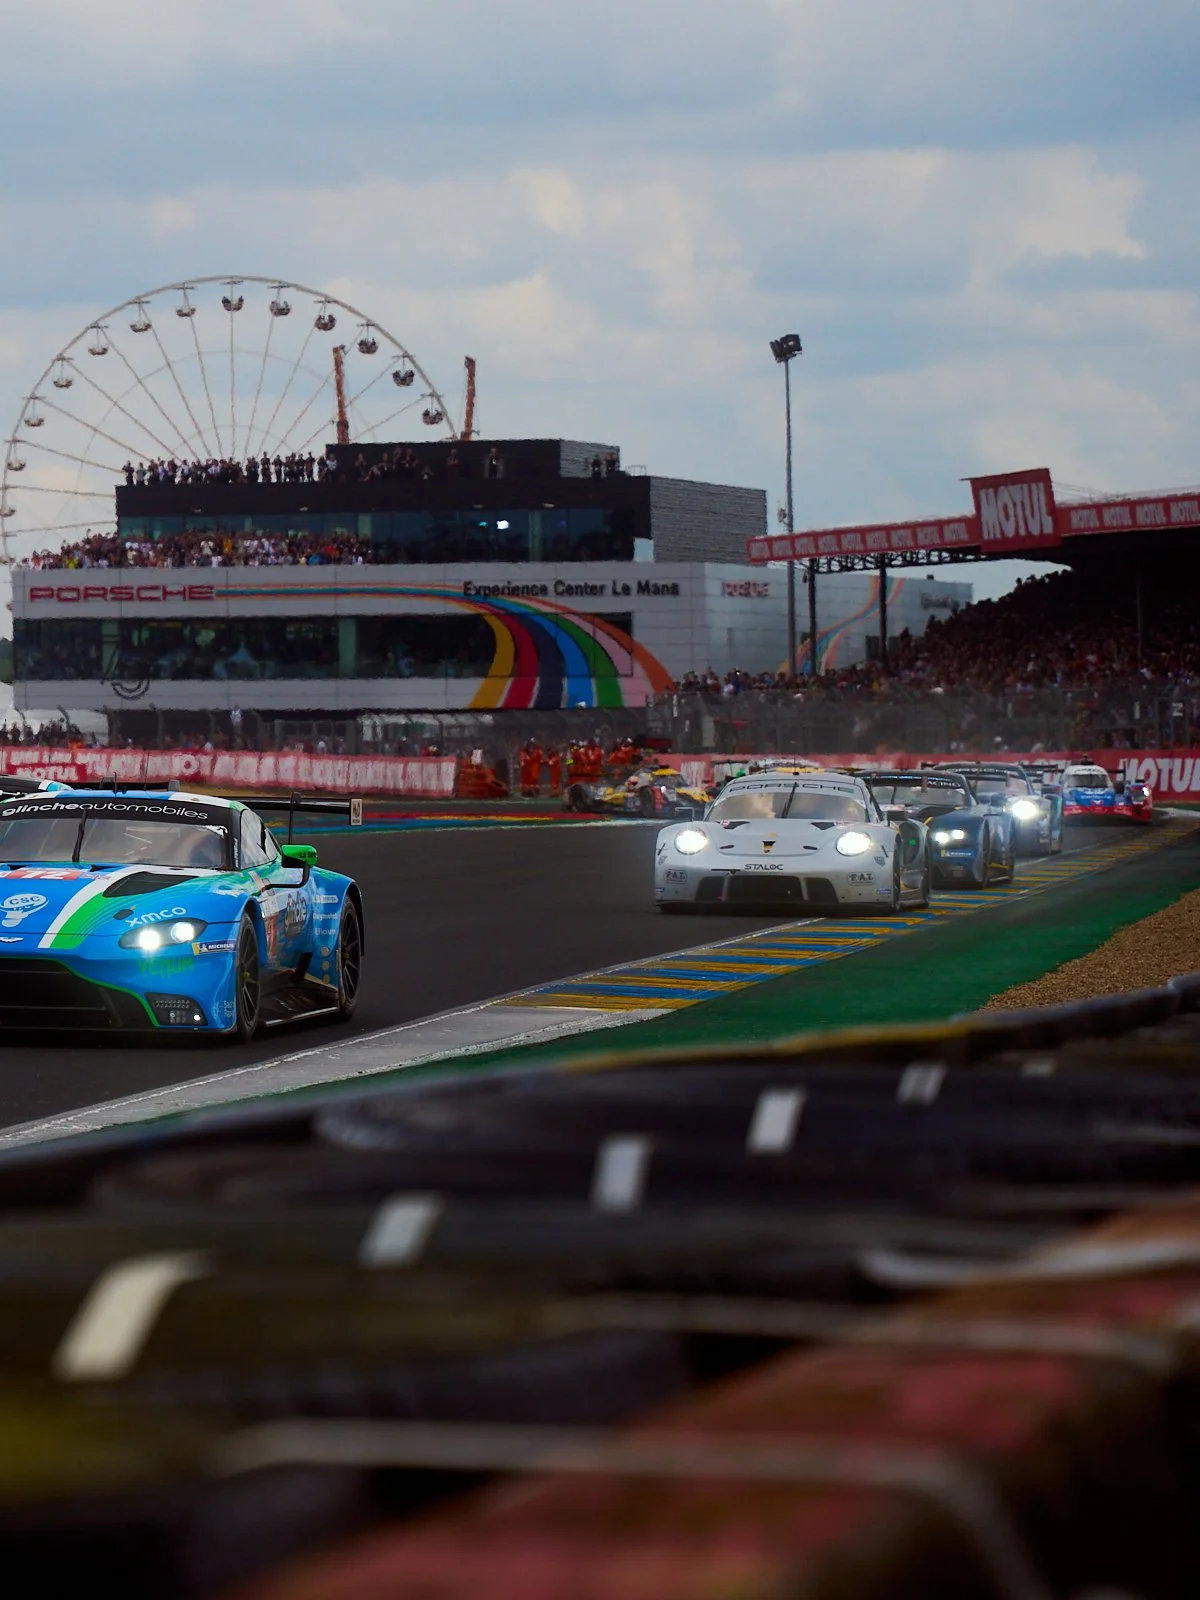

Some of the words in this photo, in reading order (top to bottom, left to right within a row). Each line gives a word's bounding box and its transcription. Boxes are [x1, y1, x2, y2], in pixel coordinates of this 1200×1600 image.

[979, 481, 1054, 540] MOTUL
[1136, 502, 1167, 525] MOTUL
[29, 585, 215, 602] PORSCHE
[463, 580, 548, 598] Experience
[554, 580, 605, 596] Center
[612, 580, 631, 596] Le
[637, 580, 680, 596] Mans
[728, 783, 855, 793] PORSCHE
[744, 863, 784, 871] STALOC
[8, 895, 41, 905] CSC
[124, 906, 187, 928] xmco
[208, 942, 235, 950] MICHELIN
